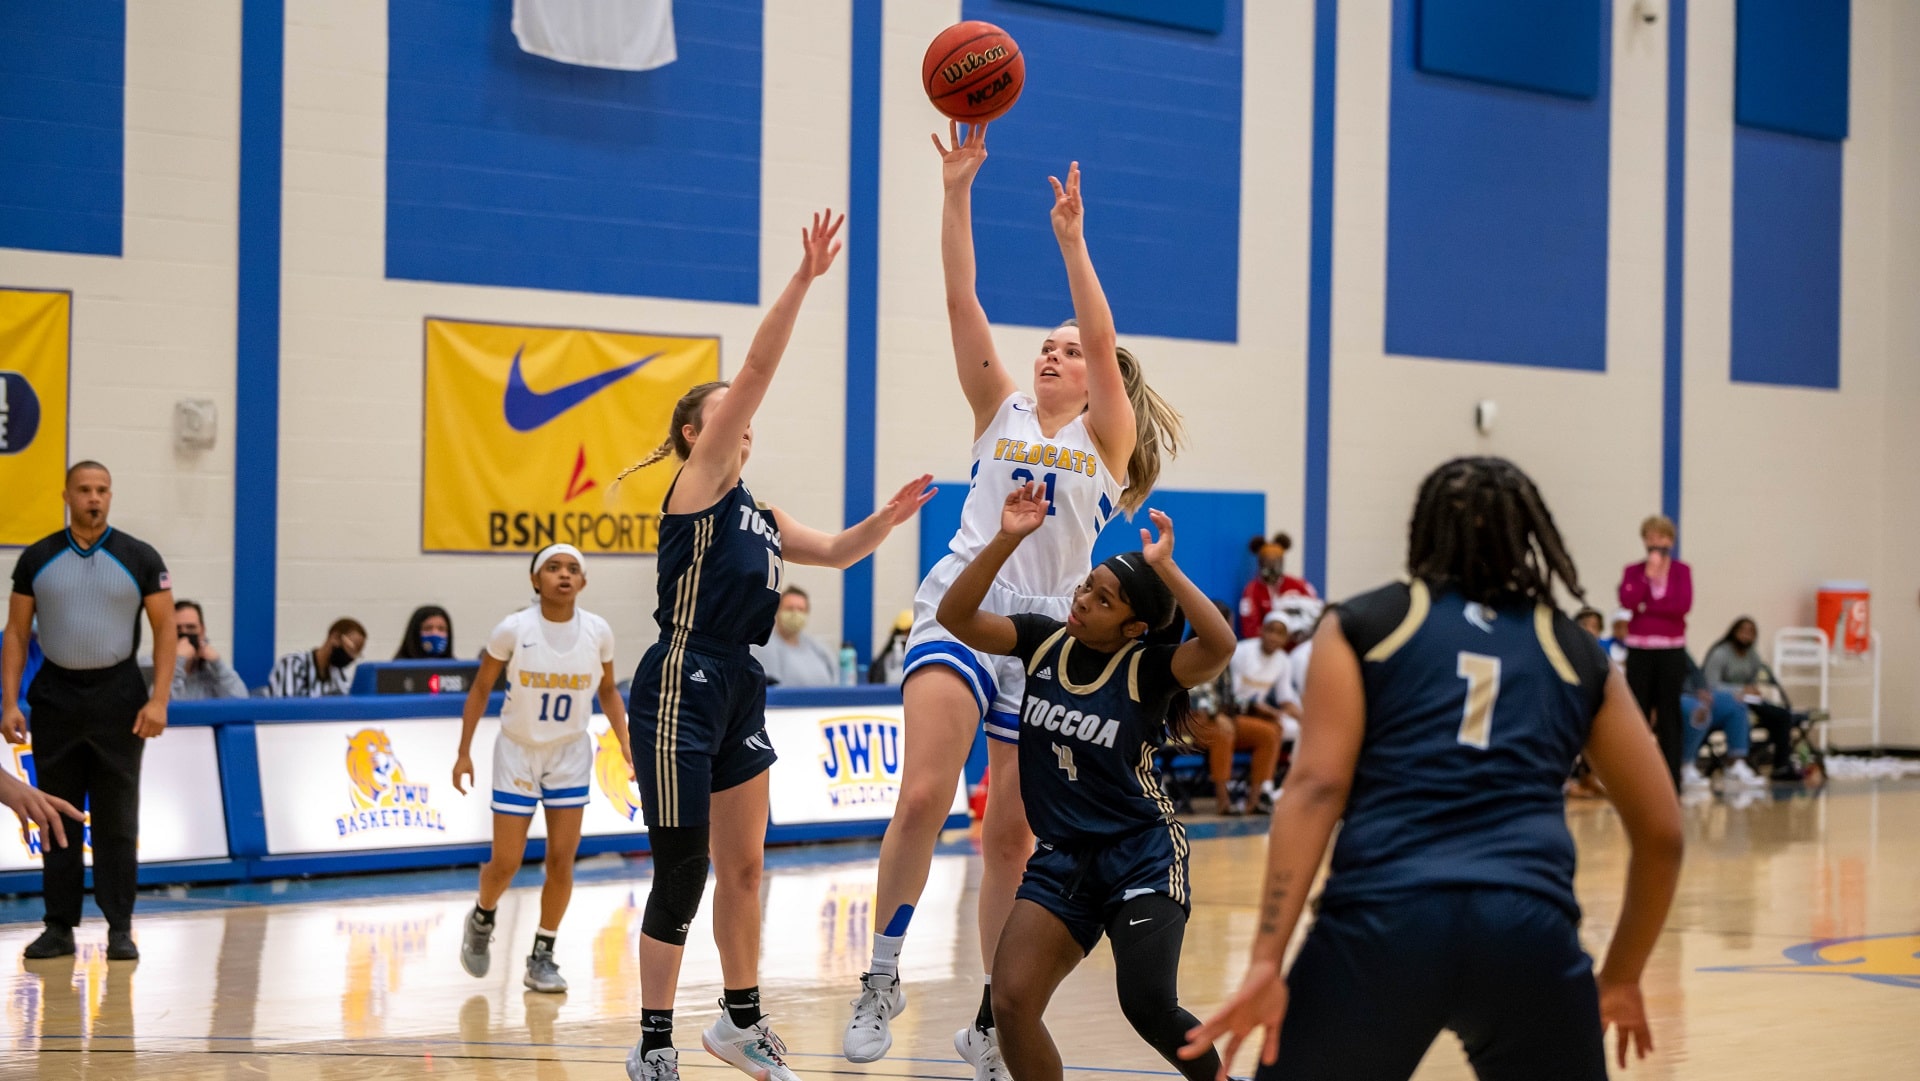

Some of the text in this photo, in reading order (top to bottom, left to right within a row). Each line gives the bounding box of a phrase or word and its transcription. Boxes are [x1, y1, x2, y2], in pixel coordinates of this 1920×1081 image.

[942, 45, 1007, 83] Wilson
[967, 71, 1012, 106] NCAA
[994, 438, 1096, 477] WILDCATS
[489, 512, 556, 547] BSN
[739, 504, 781, 550] TOCC
[538, 692, 572, 722] 10
[1456, 651, 1501, 750] 1
[1023, 694, 1120, 749] TOCCOA
[822, 722, 898, 779] JWU
[1051, 741, 1078, 781] 4
[393, 784, 429, 804] JWU
[336, 808, 446, 836] BASKETBALL
